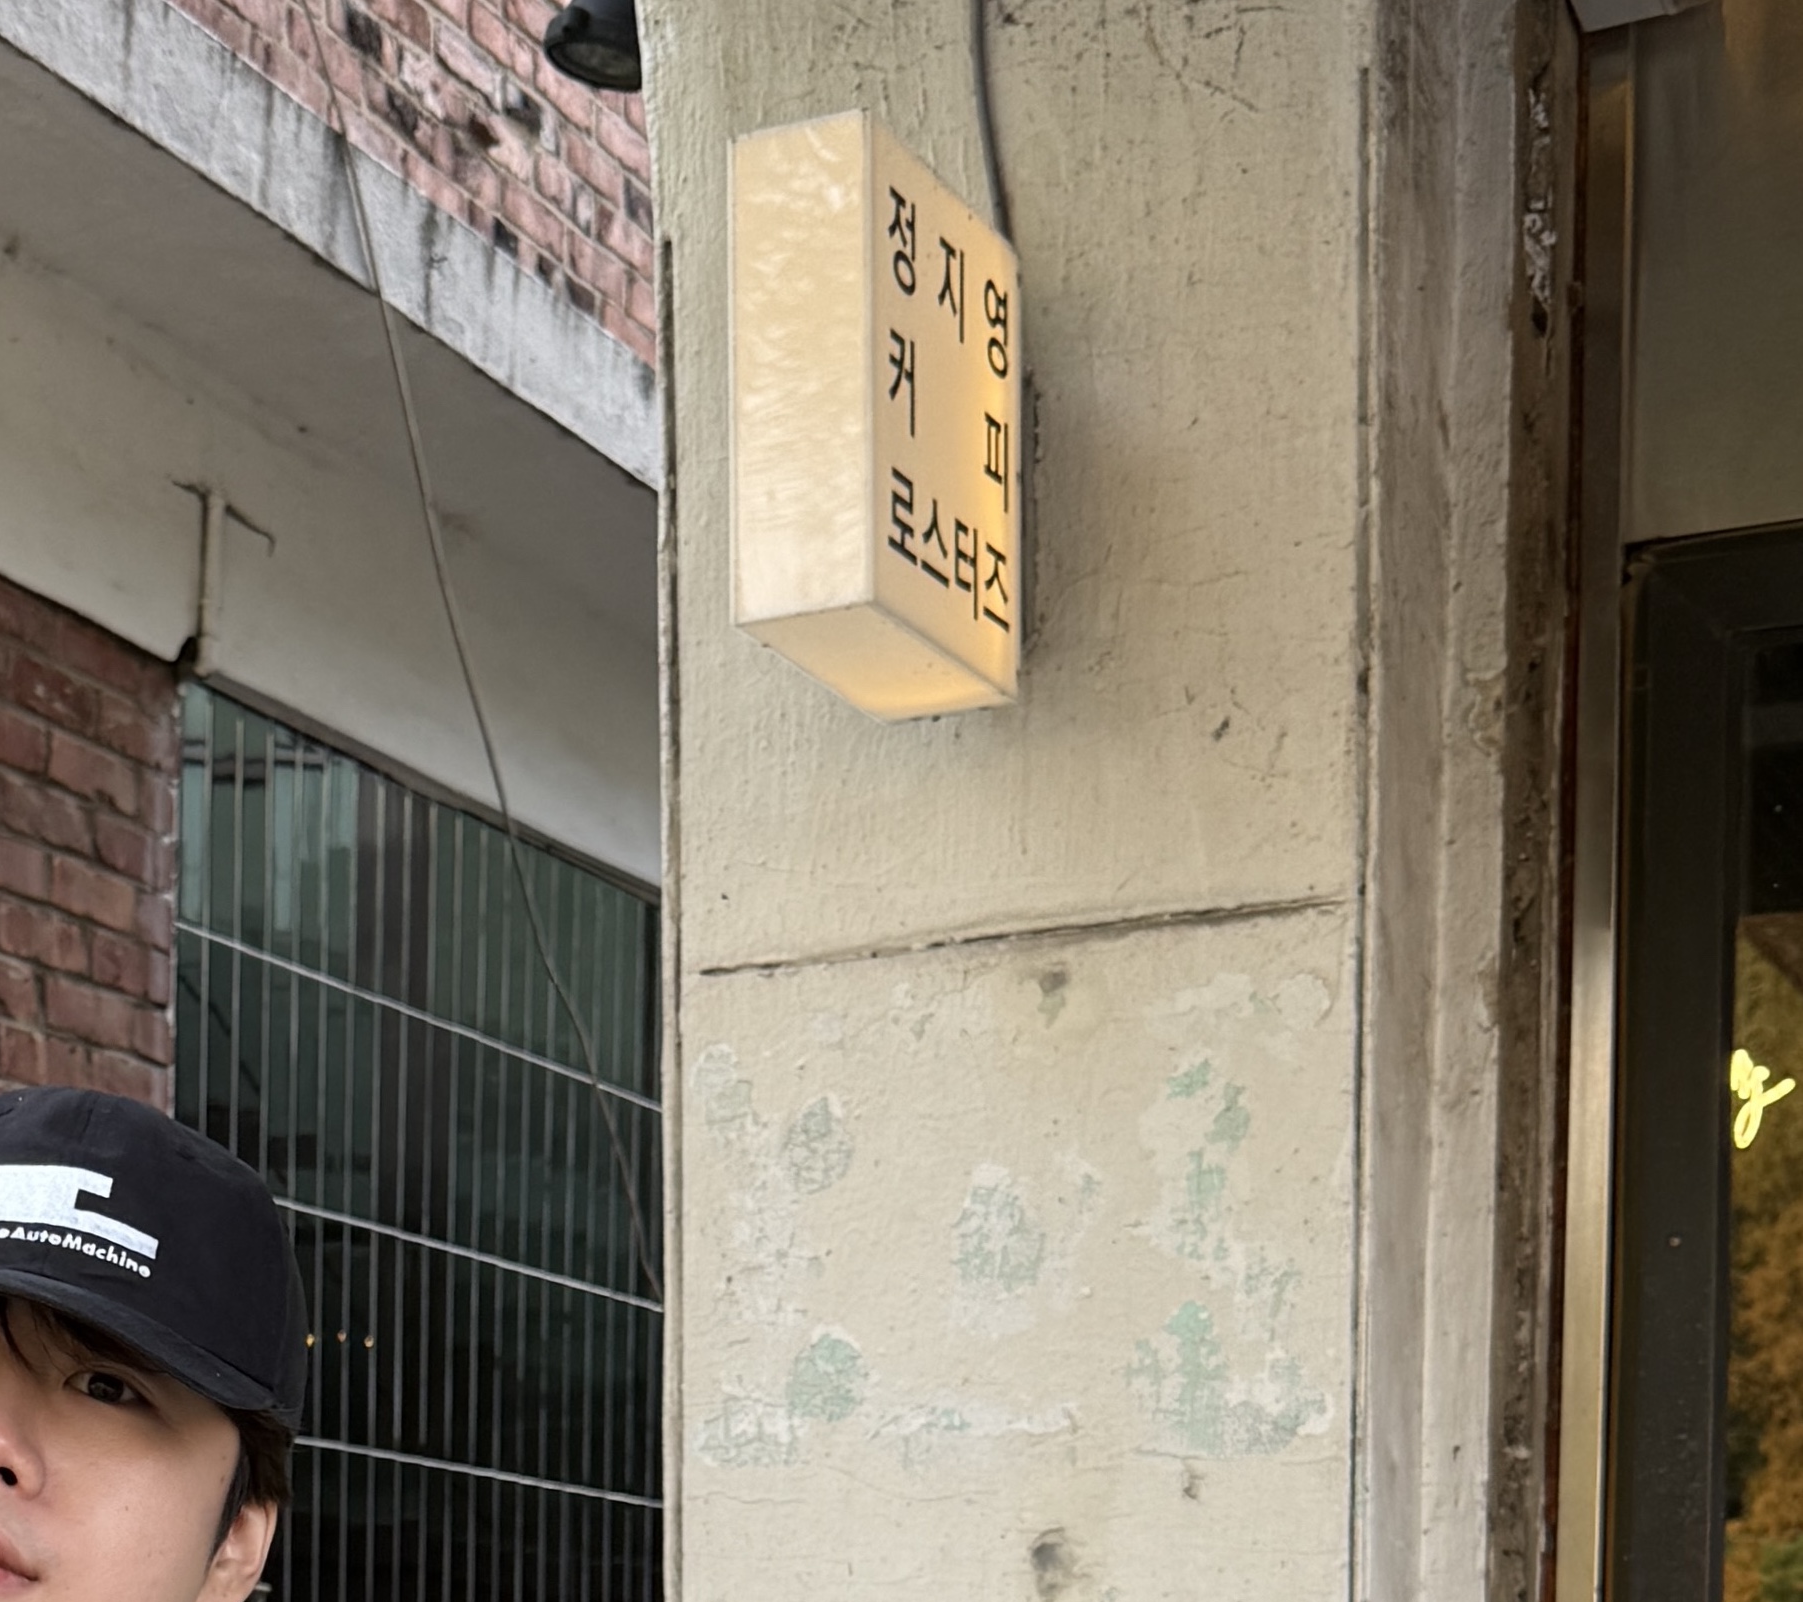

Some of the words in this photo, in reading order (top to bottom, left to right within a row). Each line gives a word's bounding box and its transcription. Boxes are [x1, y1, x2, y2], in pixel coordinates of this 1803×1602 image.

[888, 185, 1010, 382] 정지영
[888, 327, 1010, 514] 커피
[888, 466, 1010, 634] 로스터즈
